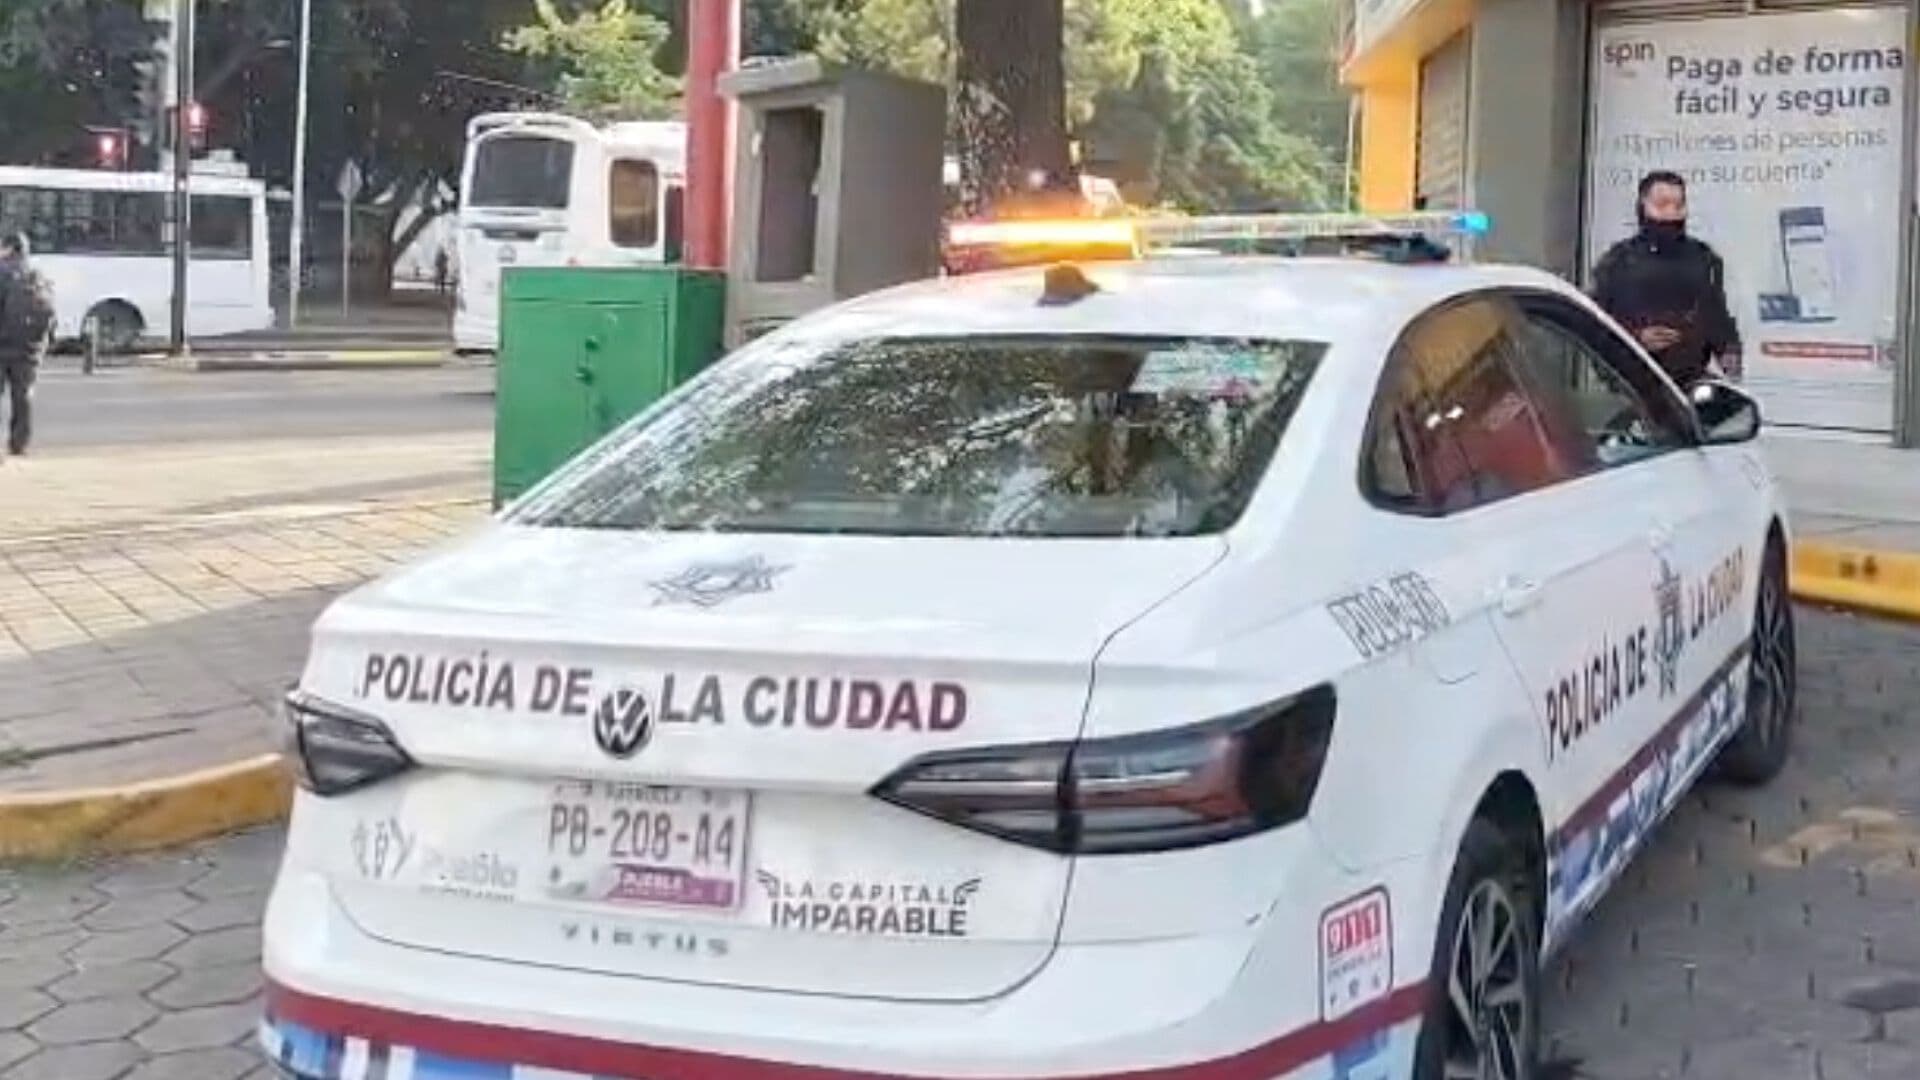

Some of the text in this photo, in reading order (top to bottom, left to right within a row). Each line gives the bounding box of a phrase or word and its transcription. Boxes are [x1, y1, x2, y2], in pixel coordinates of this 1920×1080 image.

[1604, 42, 1655, 68] spin
[1667, 44, 1904, 85] Paga de forma
[1675, 84, 1890, 119] fácil y segura
[1743, 128, 1771, 150] de
[1778, 127, 1887, 154] personas
[1711, 164, 1737, 183] su
[1624, 624, 1646, 698] DE
[361, 651, 968, 732] POLICÍA DE LA CIUDAD
[784, 880, 949, 905] LA CAPITAL
[769, 900, 967, 936] IMPARABLE
[561, 923, 729, 954] VIRTUS
